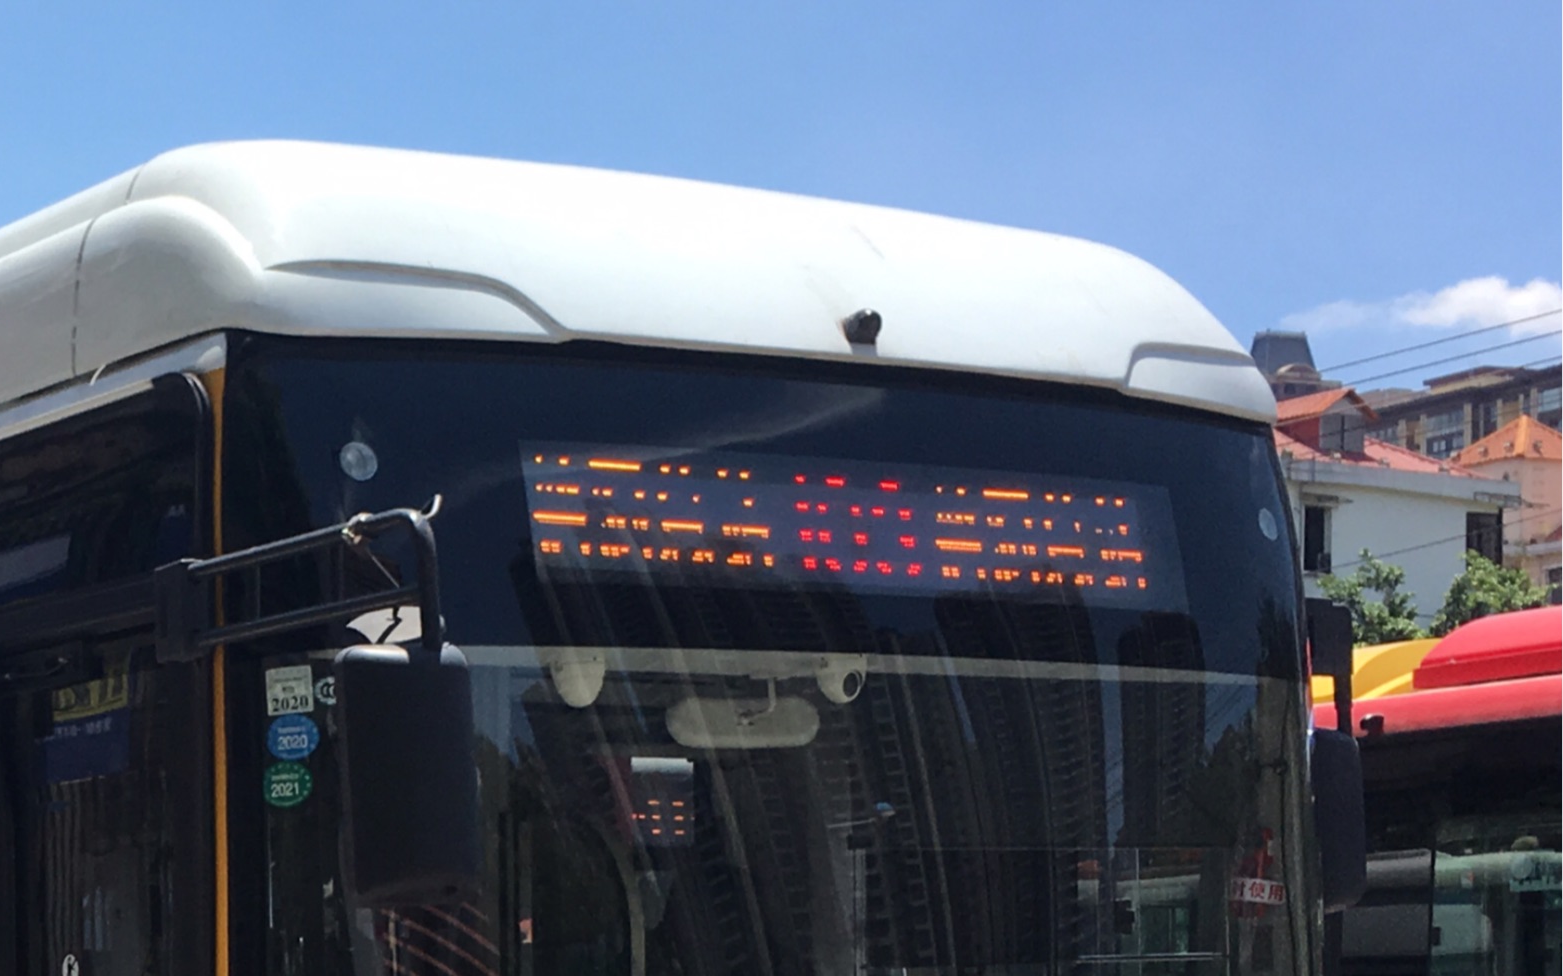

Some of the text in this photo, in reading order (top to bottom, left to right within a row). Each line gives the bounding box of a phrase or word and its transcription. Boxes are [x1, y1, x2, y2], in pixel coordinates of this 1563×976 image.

[271, 695, 309, 713] 2020
[277, 734, 308, 751] 2020
[270, 782, 300, 798] 2021
